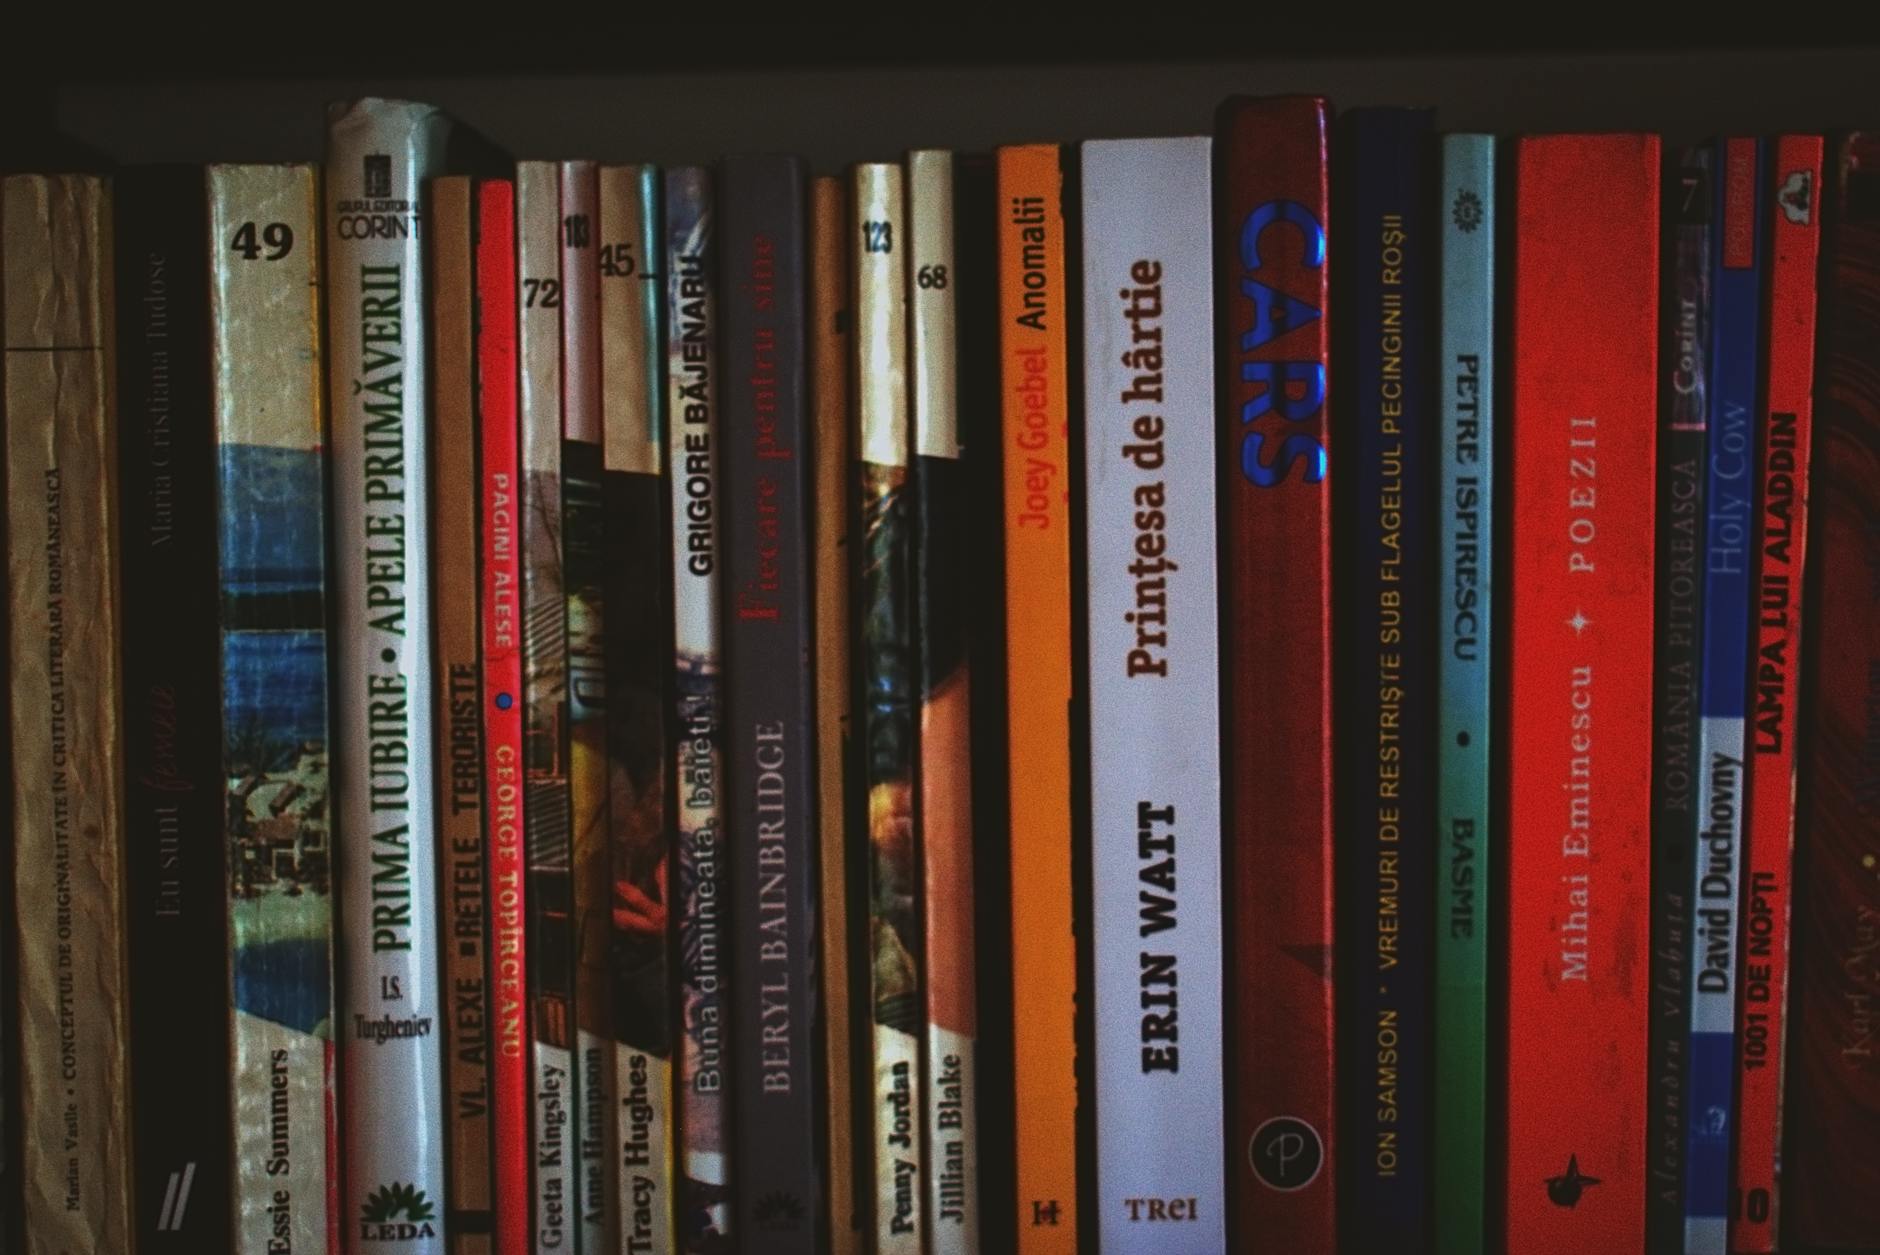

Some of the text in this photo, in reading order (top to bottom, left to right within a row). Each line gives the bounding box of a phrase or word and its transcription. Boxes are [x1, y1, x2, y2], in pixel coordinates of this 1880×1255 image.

[231, 221, 294, 261] 49
[337, 214, 421, 240] CORINT
[523, 278, 561, 308] 72
[600, 243, 635, 278] 45
[738, 232, 778, 312] sine
[863, 220, 892, 253] 123
[918, 263, 948, 290] 68
[1011, 197, 1047, 332] Anomalii
[1240, 200, 1328, 488] CARS
[1380, 292, 1403, 434] PECINGINII
[353, 263, 406, 636] APELE PRIMĂVERII
[678, 256, 714, 576] GRIGORE BĂJENARU
[1014, 348, 1058, 531] Joey Goebel
[1119, 260, 1178, 679] Prințesa de hârtie
[1708, 399, 1752, 574] Holy Cow
[147, 474, 173, 546] Maria
[494, 472, 514, 652] PAGINI ALESE
[1380, 441, 1402, 581] FLAGELUL
[1453, 353, 1479, 662] PETRE ISPIRESCU
[1567, 414, 1598, 574] POEZII
[1380, 590, 1402, 644] SUB
[1756, 410, 1797, 756] LAMPA LUI ALADDIN
[50, 692, 67, 768] CRITICA
[448, 663, 480, 817] TERORISTE
[54, 796, 72, 939] ORIGINALITATE
[154, 806, 181, 918] Eu sunt
[368, 673, 411, 954] PRIMA IUBIRE
[496, 744, 517, 861] GEORGE
[1379, 806, 1401, 842] DE
[1559, 663, 1594, 983] Mihai Eminescu
[1696, 751, 1744, 995] David Duchovny
[755, 719, 791, 1094] BERYL BAINBRIDGE
[1137, 800, 1179, 1076] ERIN WATT
[1378, 846, 1401, 970] VREMURI
[1450, 817, 1475, 940] BASME
[57, 943, 72, 968] DE
[57, 971, 77, 1081] CONCEPTUL
[454, 978, 487, 1066] ALEXE
[1746, 965, 1772, 1007] DE
[458, 1076, 486, 1119] VL.
[1377, 1007, 1399, 1177] ION SAMSON
[1743, 1013, 1769, 1071] 1001
[63, 1102, 81, 1212] Marian Vasile
[265, 1048, 292, 1255] Essie Summers
[537, 1064, 567, 1249] Geeta Kingsley
[582, 1047, 609, 1225] Anne Hampson
[622, 1054, 656, 1255] Tracy Hughes
[886, 1061, 917, 1236] Penny Jordan
[936, 1054, 965, 1225] Jillian Blake
[360, 1221, 436, 1241] LEDA
